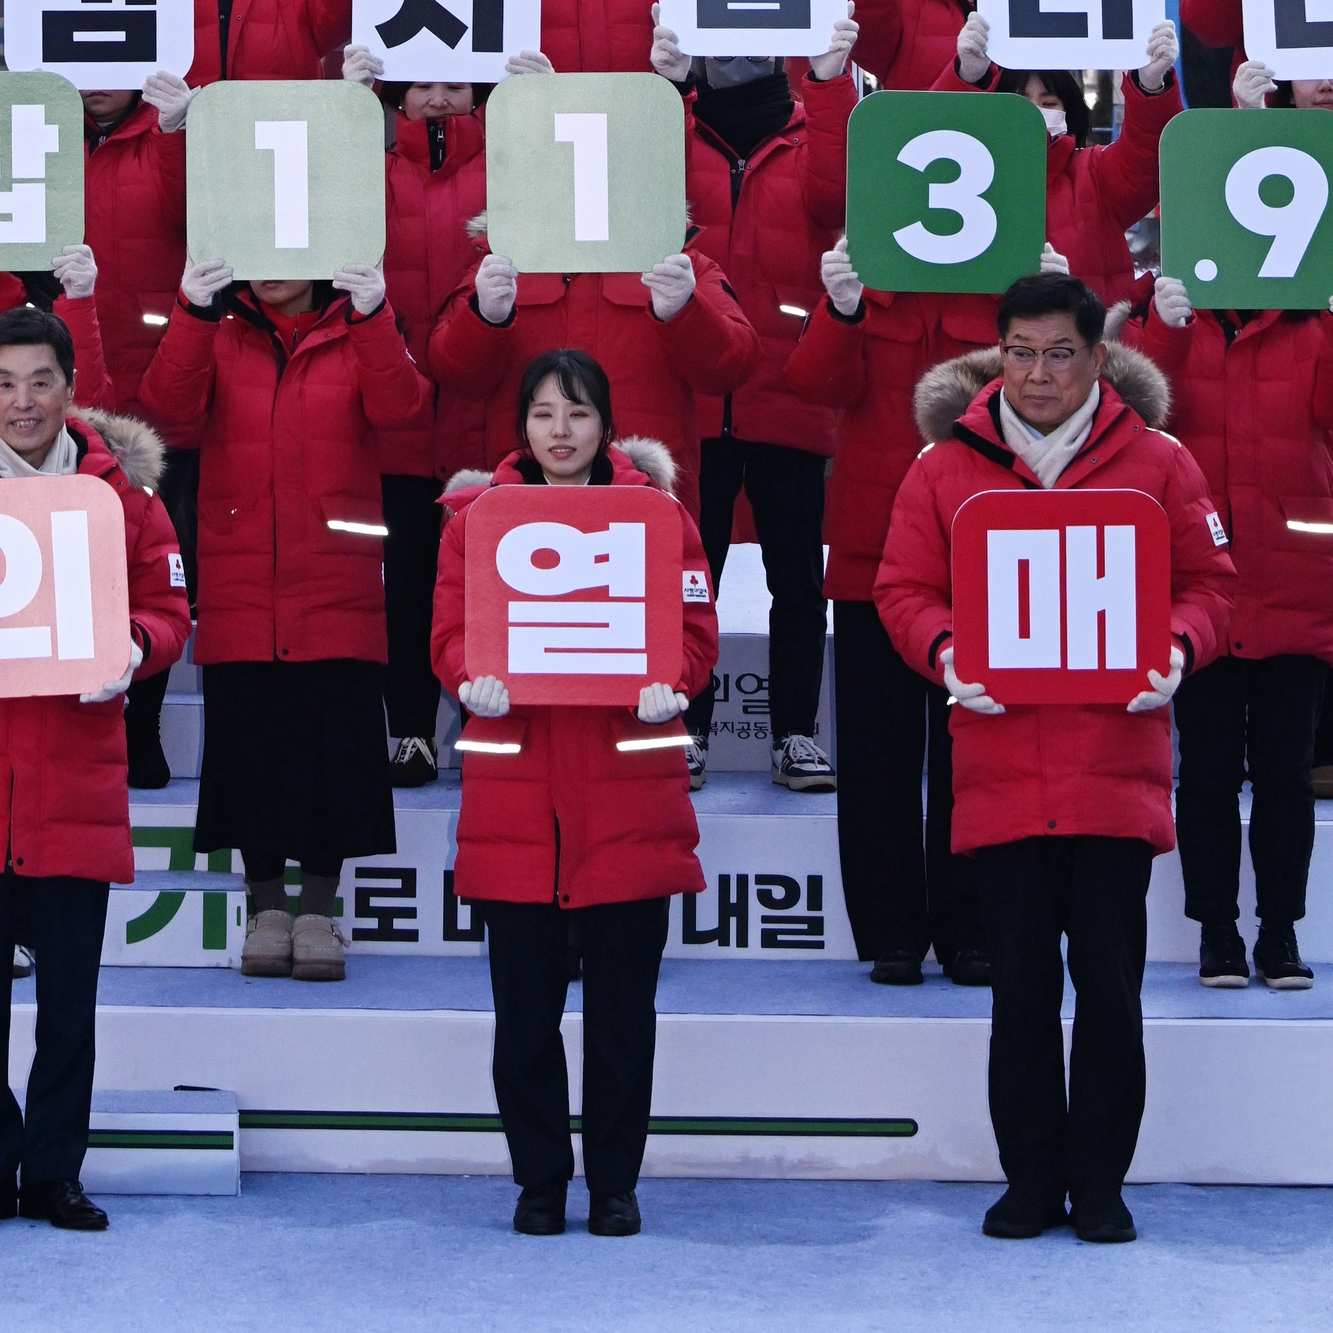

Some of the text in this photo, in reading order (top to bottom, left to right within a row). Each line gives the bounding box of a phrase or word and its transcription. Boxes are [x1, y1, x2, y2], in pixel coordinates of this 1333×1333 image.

[254, 121, 309, 249] 1
[554, 113, 609, 241] 1
[893, 129, 998, 264] 3
[1194, 146, 1329, 281] .9
[496, 522, 647, 675] 열
[986, 525, 1137, 670] 매
[682, 873, 825, 949] 내일
